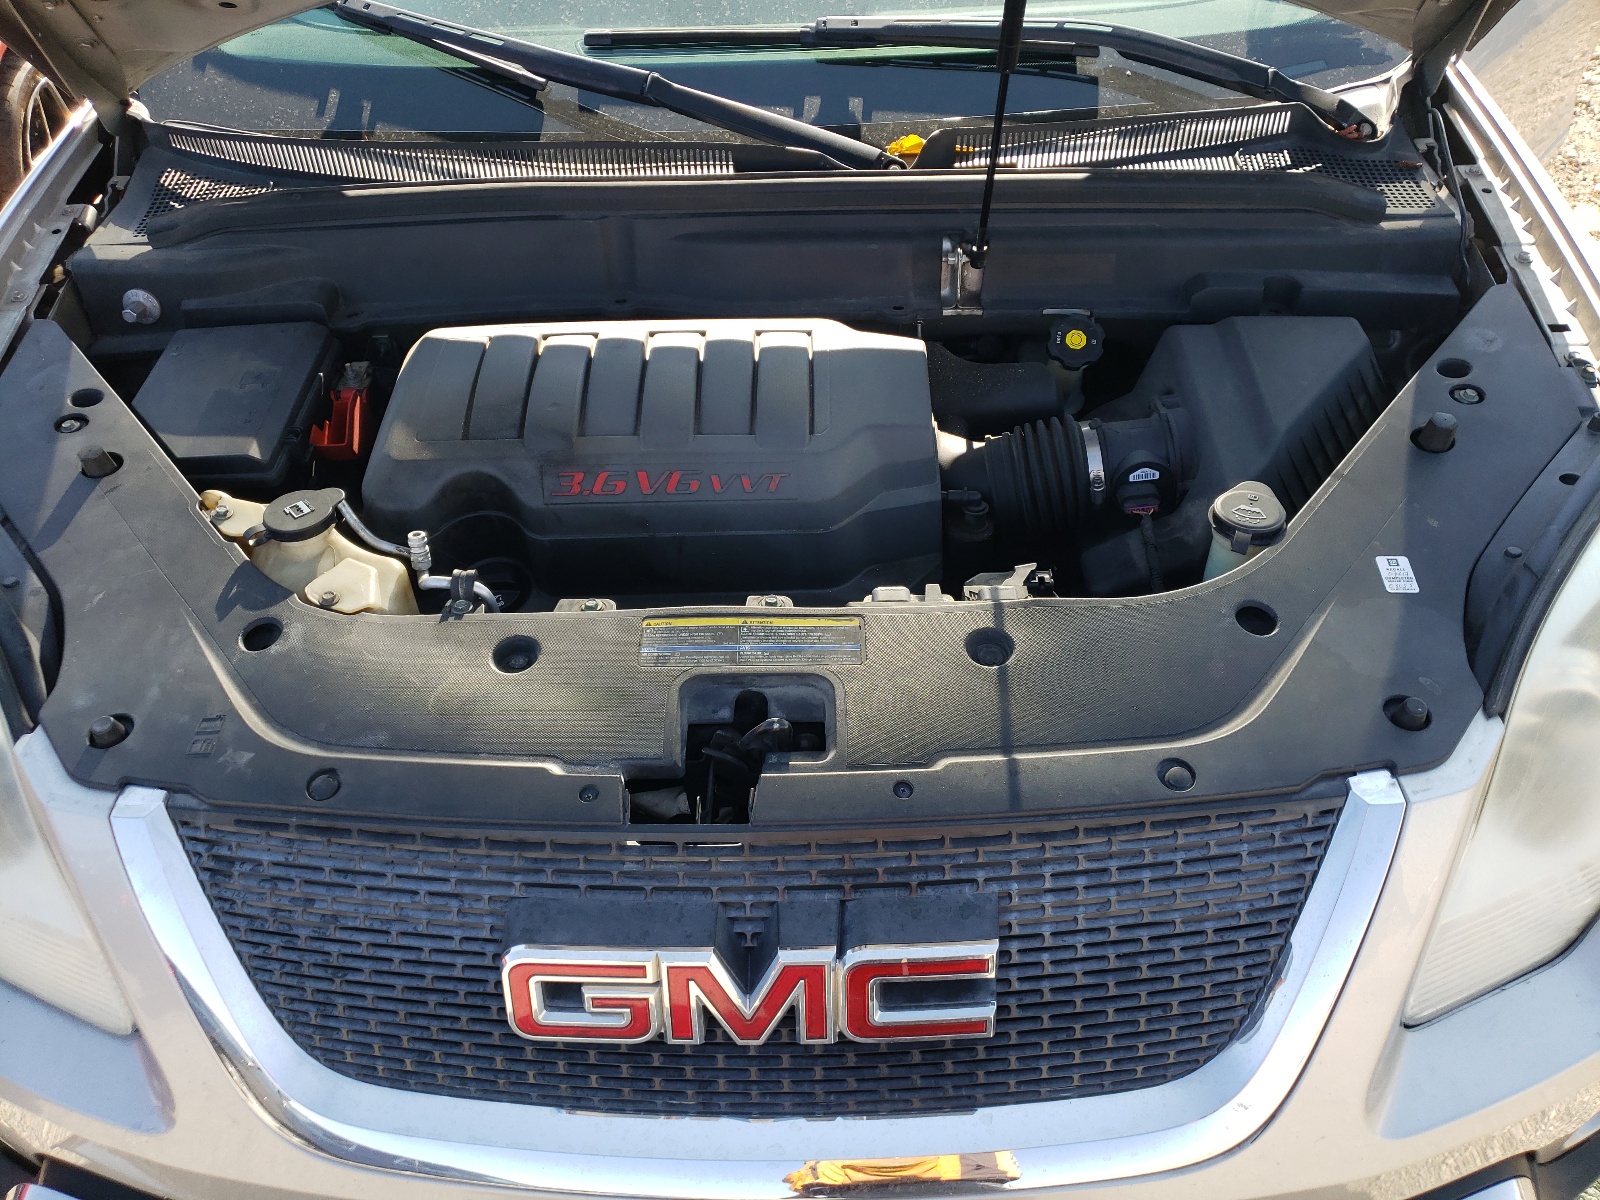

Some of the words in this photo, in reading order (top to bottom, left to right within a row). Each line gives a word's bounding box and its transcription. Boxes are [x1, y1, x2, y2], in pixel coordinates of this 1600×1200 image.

[551, 470, 629, 497] 3.6
[636, 470, 703, 496] V6
[710, 472, 791, 494] VVT
[502, 939, 998, 1046] GMC
